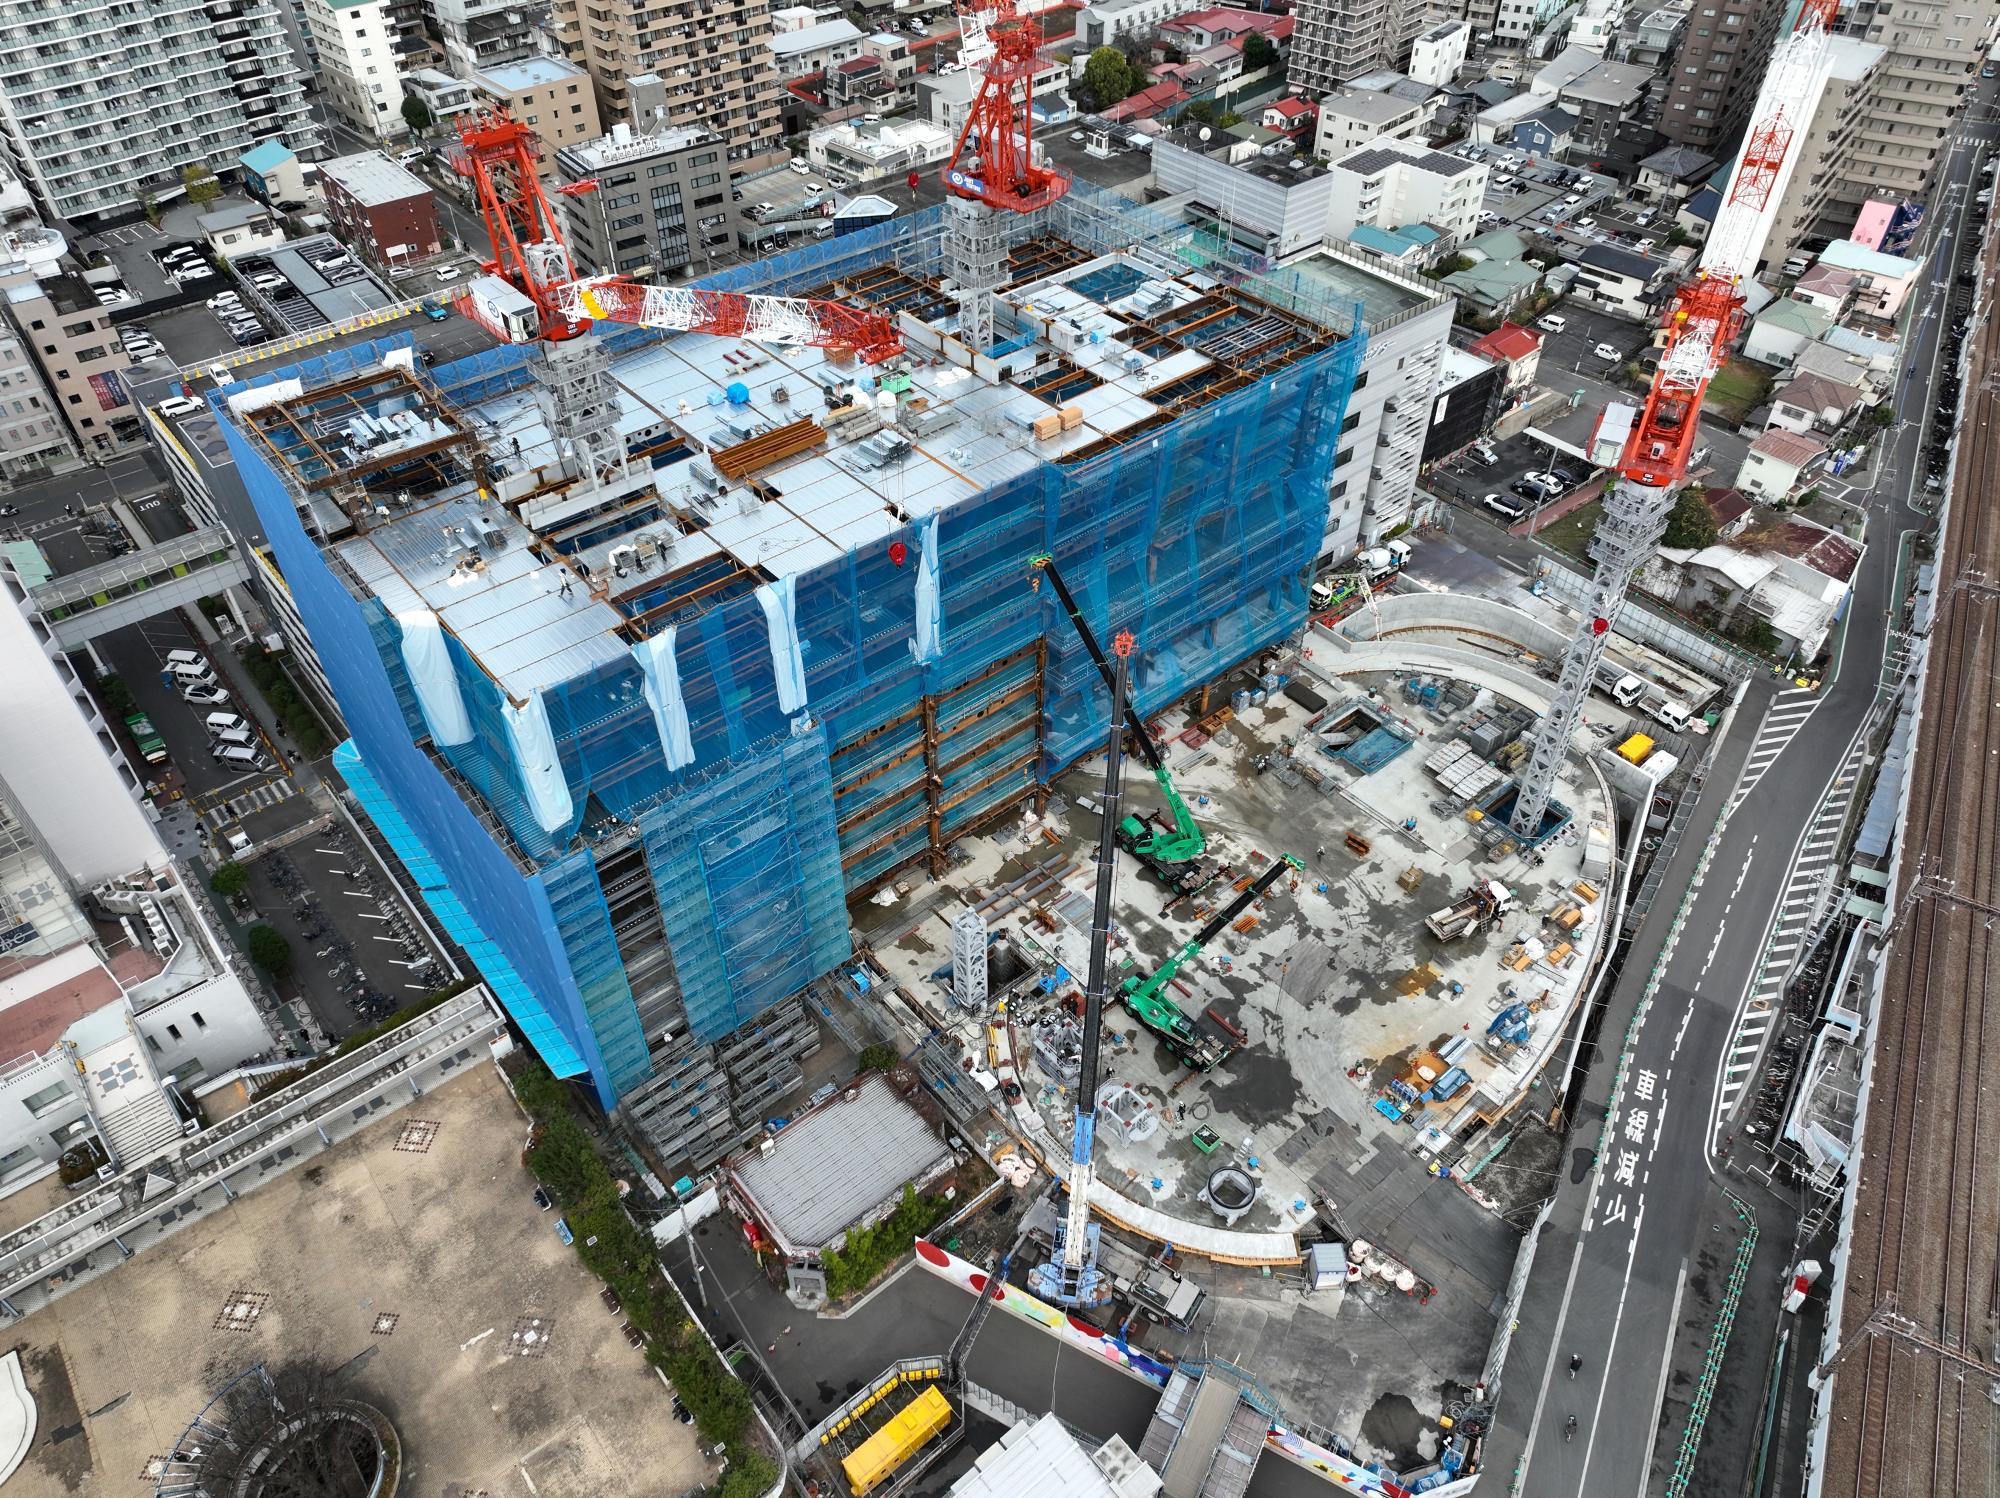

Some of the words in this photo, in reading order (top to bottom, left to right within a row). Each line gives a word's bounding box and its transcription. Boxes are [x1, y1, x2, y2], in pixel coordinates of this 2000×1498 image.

[139, 500, 161, 512] OUT
[1602, 1068, 1658, 1226] 車線減少
